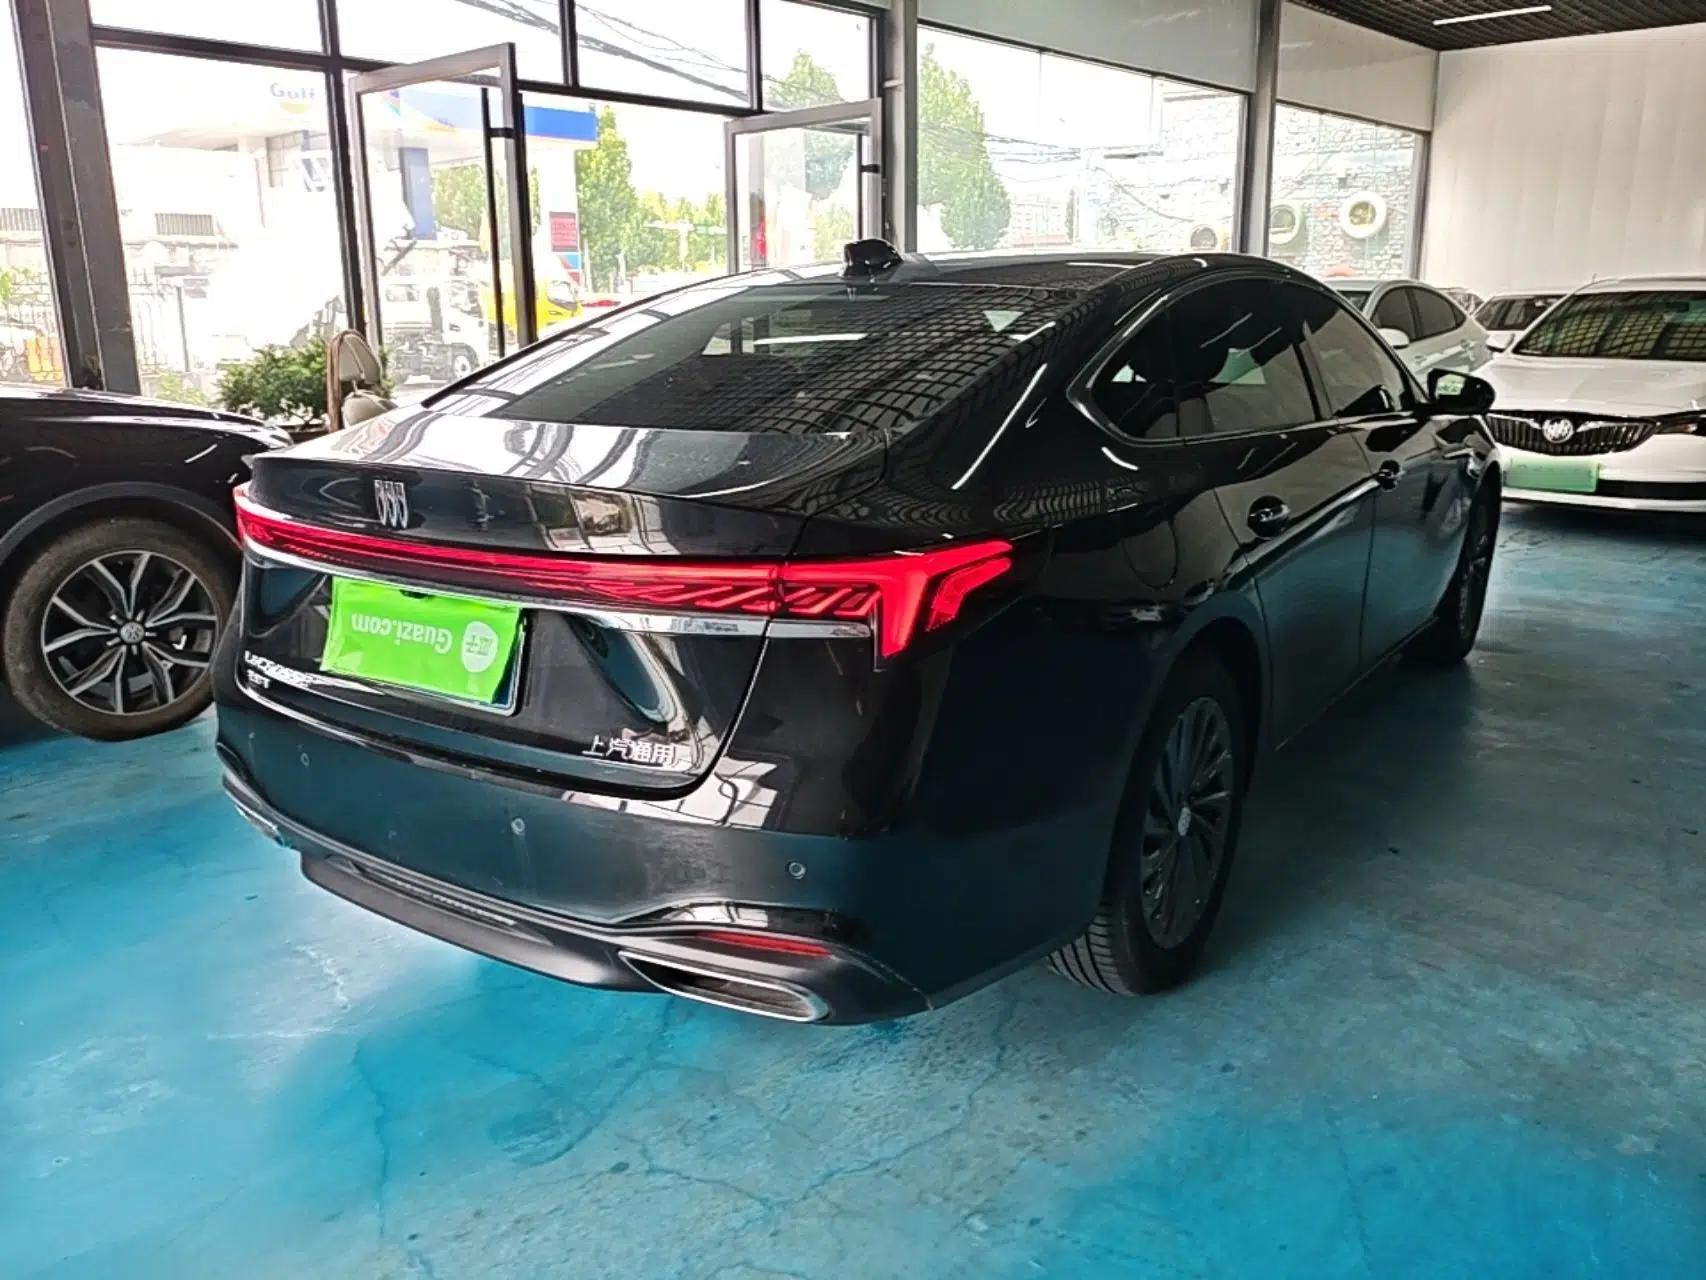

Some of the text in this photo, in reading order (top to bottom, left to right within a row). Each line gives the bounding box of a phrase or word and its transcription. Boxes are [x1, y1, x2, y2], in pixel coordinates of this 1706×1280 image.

[351, 612, 453, 655] Guazi.com
[582, 735, 676, 765] 上汽通用
